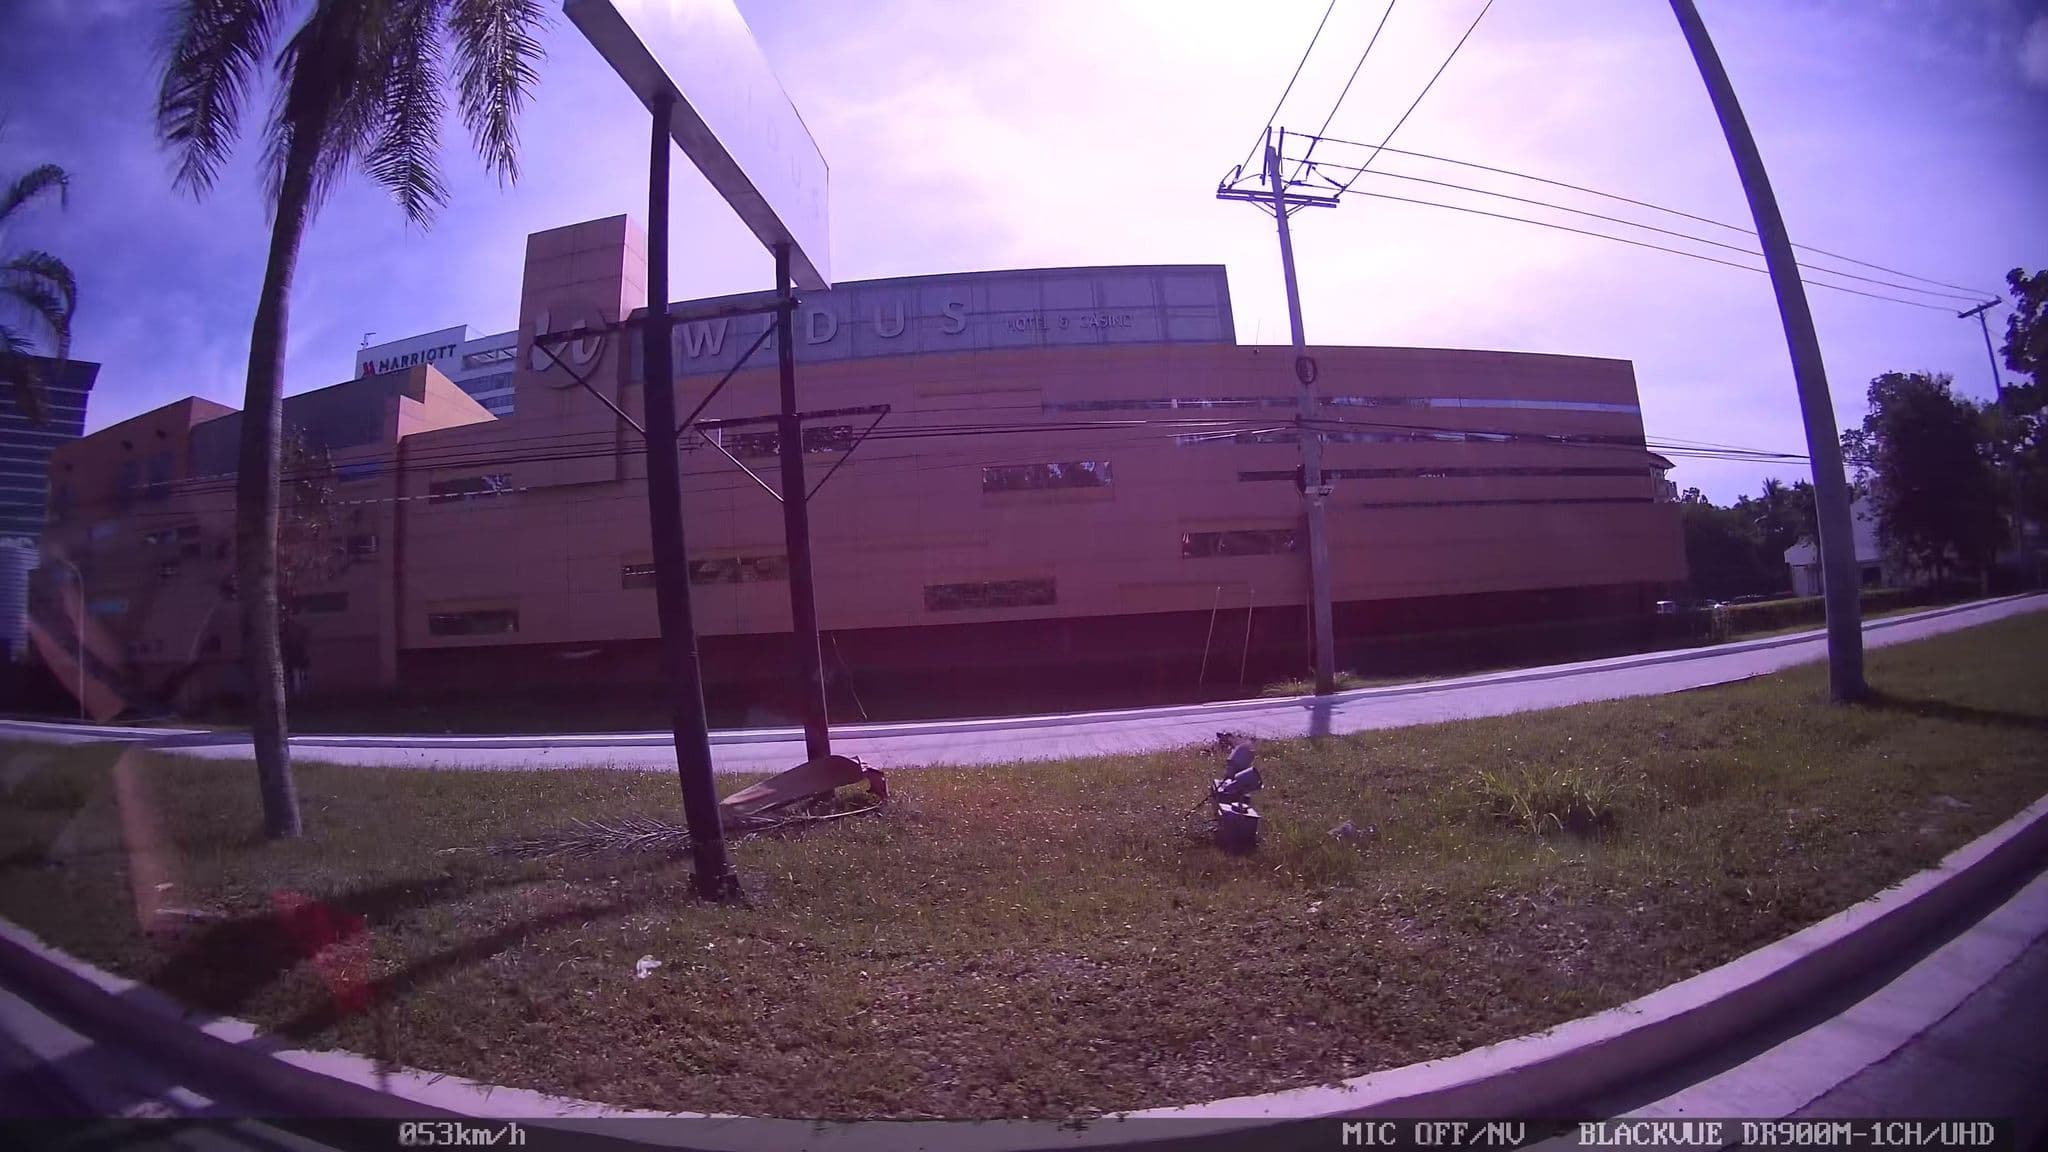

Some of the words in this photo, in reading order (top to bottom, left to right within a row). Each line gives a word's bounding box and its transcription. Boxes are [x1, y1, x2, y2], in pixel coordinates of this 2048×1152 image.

[682, 302, 967, 359] WIDUS
[1008, 314, 1050, 333] HOTEL
[1080, 313, 1136, 330] CASINO
[379, 344, 457, 373] MARRIOTT
